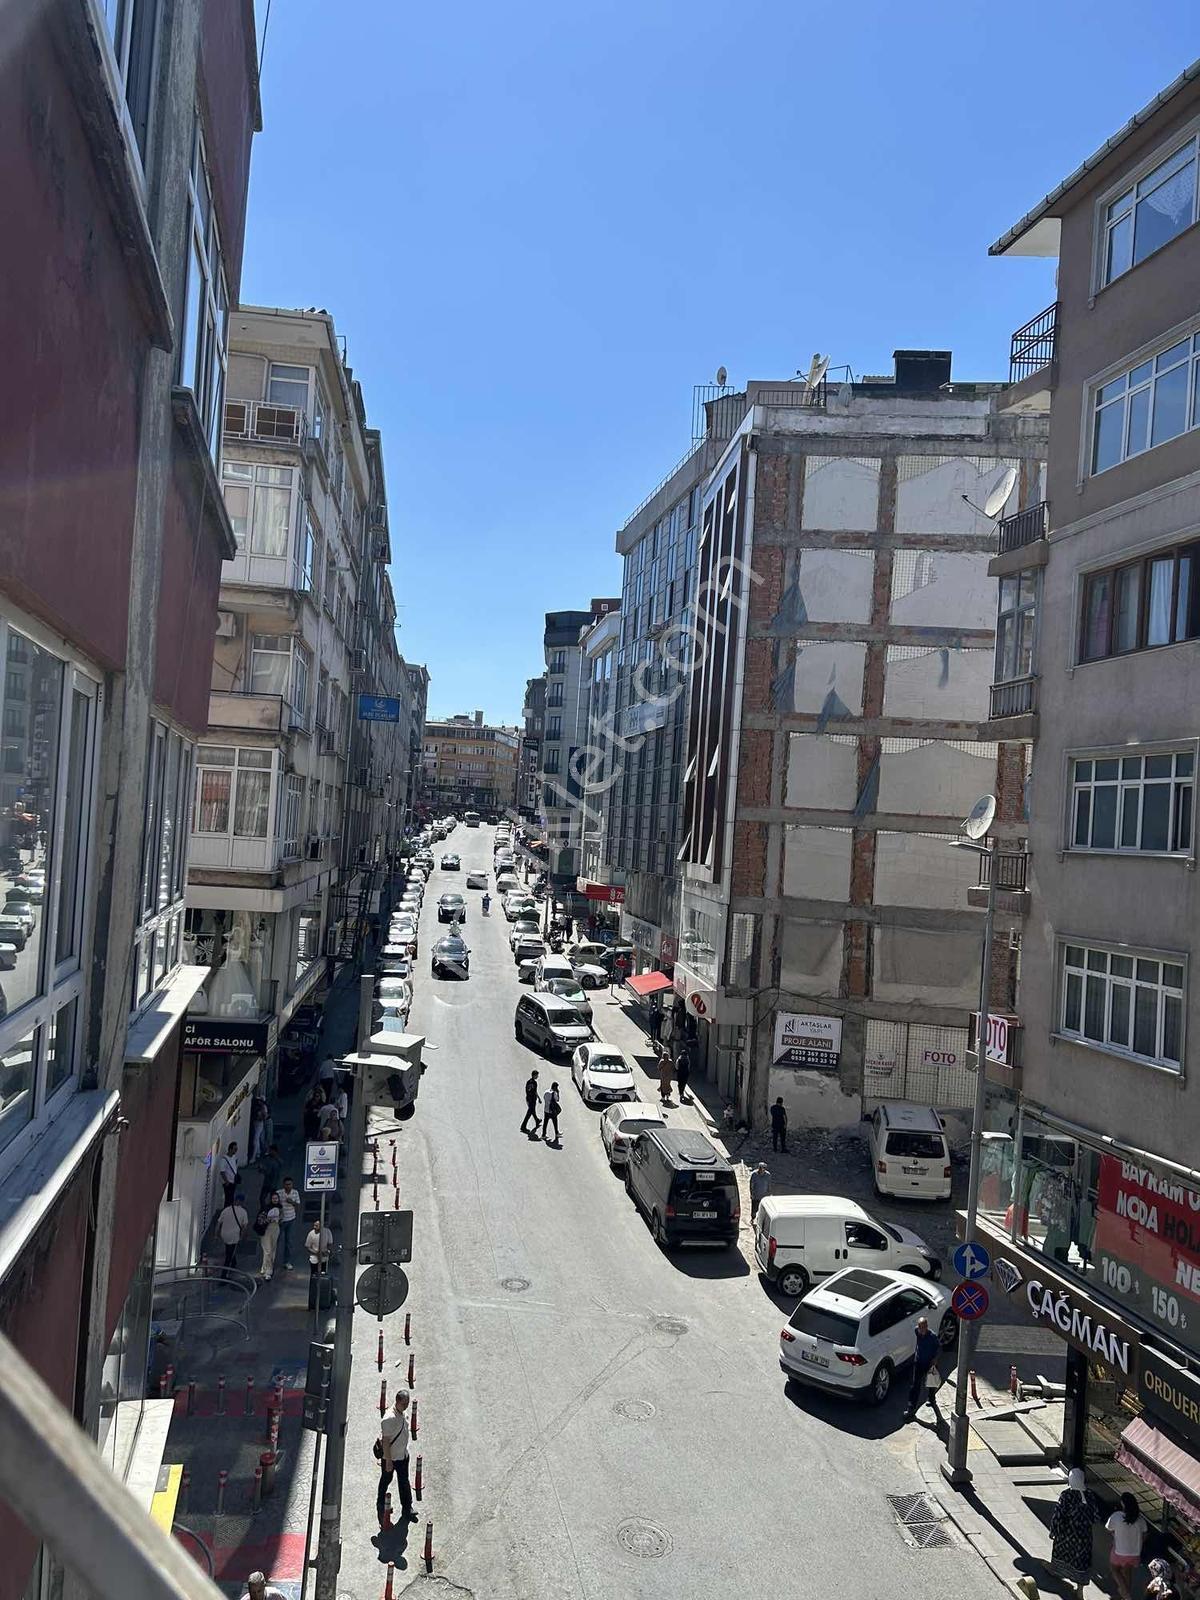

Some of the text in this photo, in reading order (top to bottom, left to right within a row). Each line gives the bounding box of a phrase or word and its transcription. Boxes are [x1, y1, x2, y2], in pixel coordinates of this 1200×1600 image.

[527, 756, 538, 802] HOTEL
[213, 1038, 254, 1047] SALONU
[783, 1037, 831, 1048] PROJE ALANI
[978, 1016, 1006, 1051] OTO
[924, 1051, 956, 1065] FOTO
[1116, 1189, 1159, 1233] MODA
[1102, 1256, 1132, 1294] 100
[1151, 1286, 1180, 1327] 150
[1027, 1280, 1130, 1375] ÇAĞMAN
[1145, 1370, 1200, 1424] ORDUER
